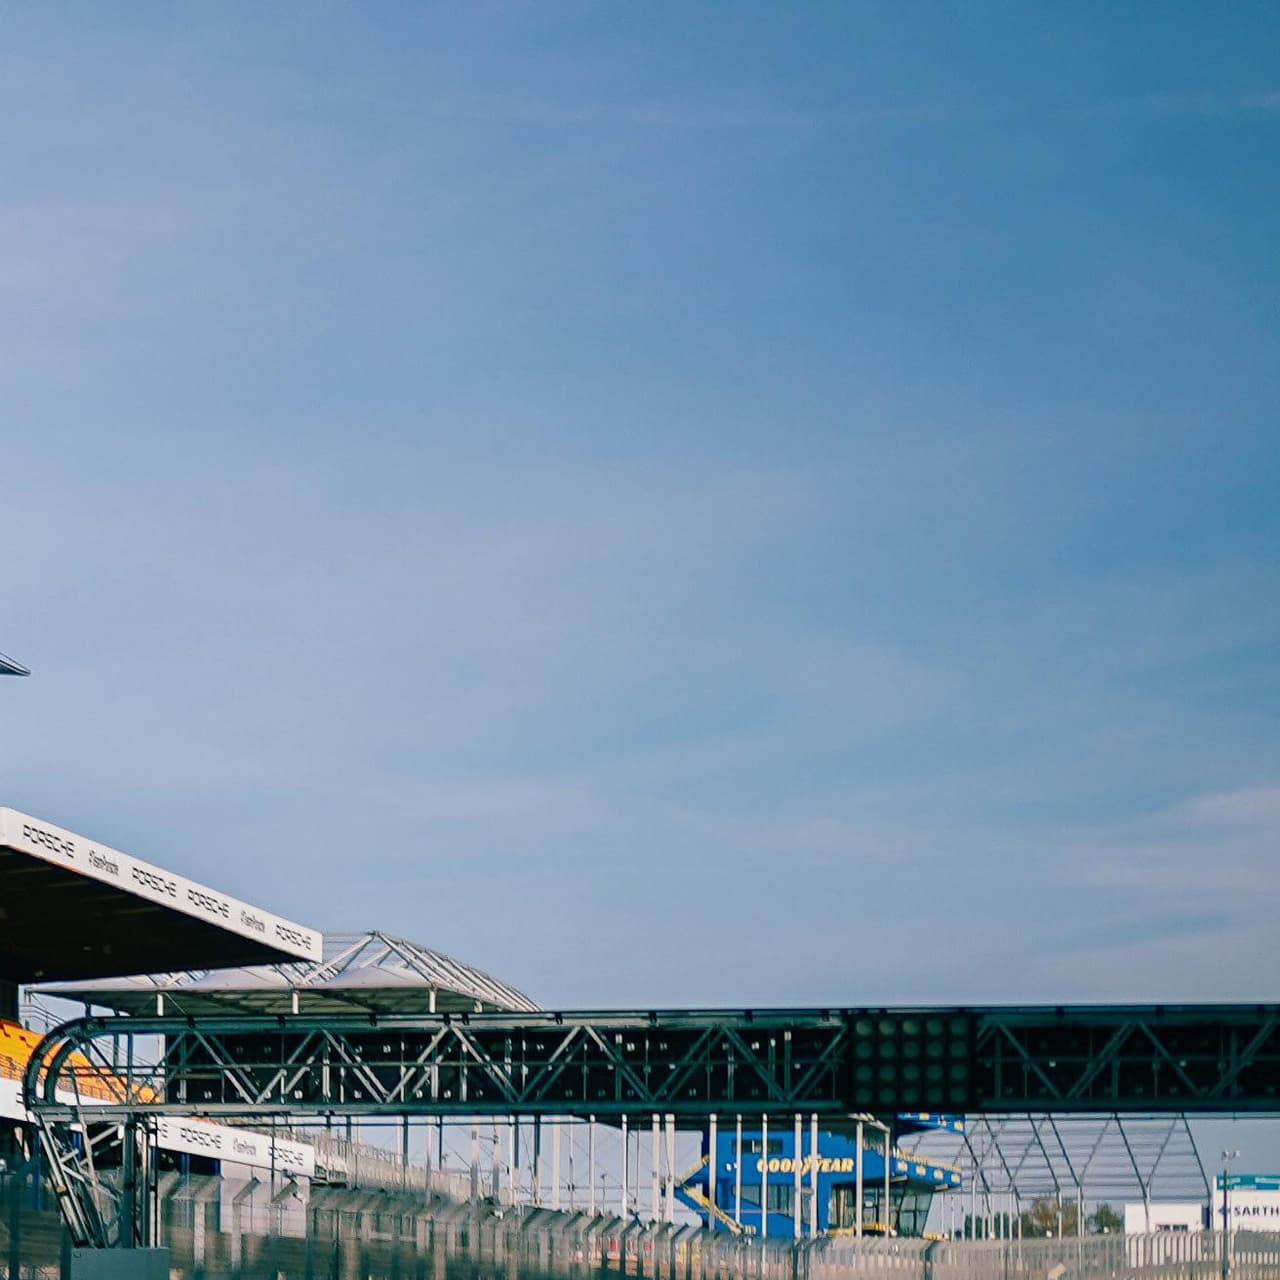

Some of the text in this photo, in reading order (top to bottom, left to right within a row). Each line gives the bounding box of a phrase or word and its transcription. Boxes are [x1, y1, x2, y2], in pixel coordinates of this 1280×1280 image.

[23, 824, 75, 859] PORSCHE
[132, 867, 177, 898] PORSCHE
[187, 888, 230, 919] PORSCHE
[275, 924, 312, 950] PORSCHE
[180, 1127, 222, 1149] PORSCHE
